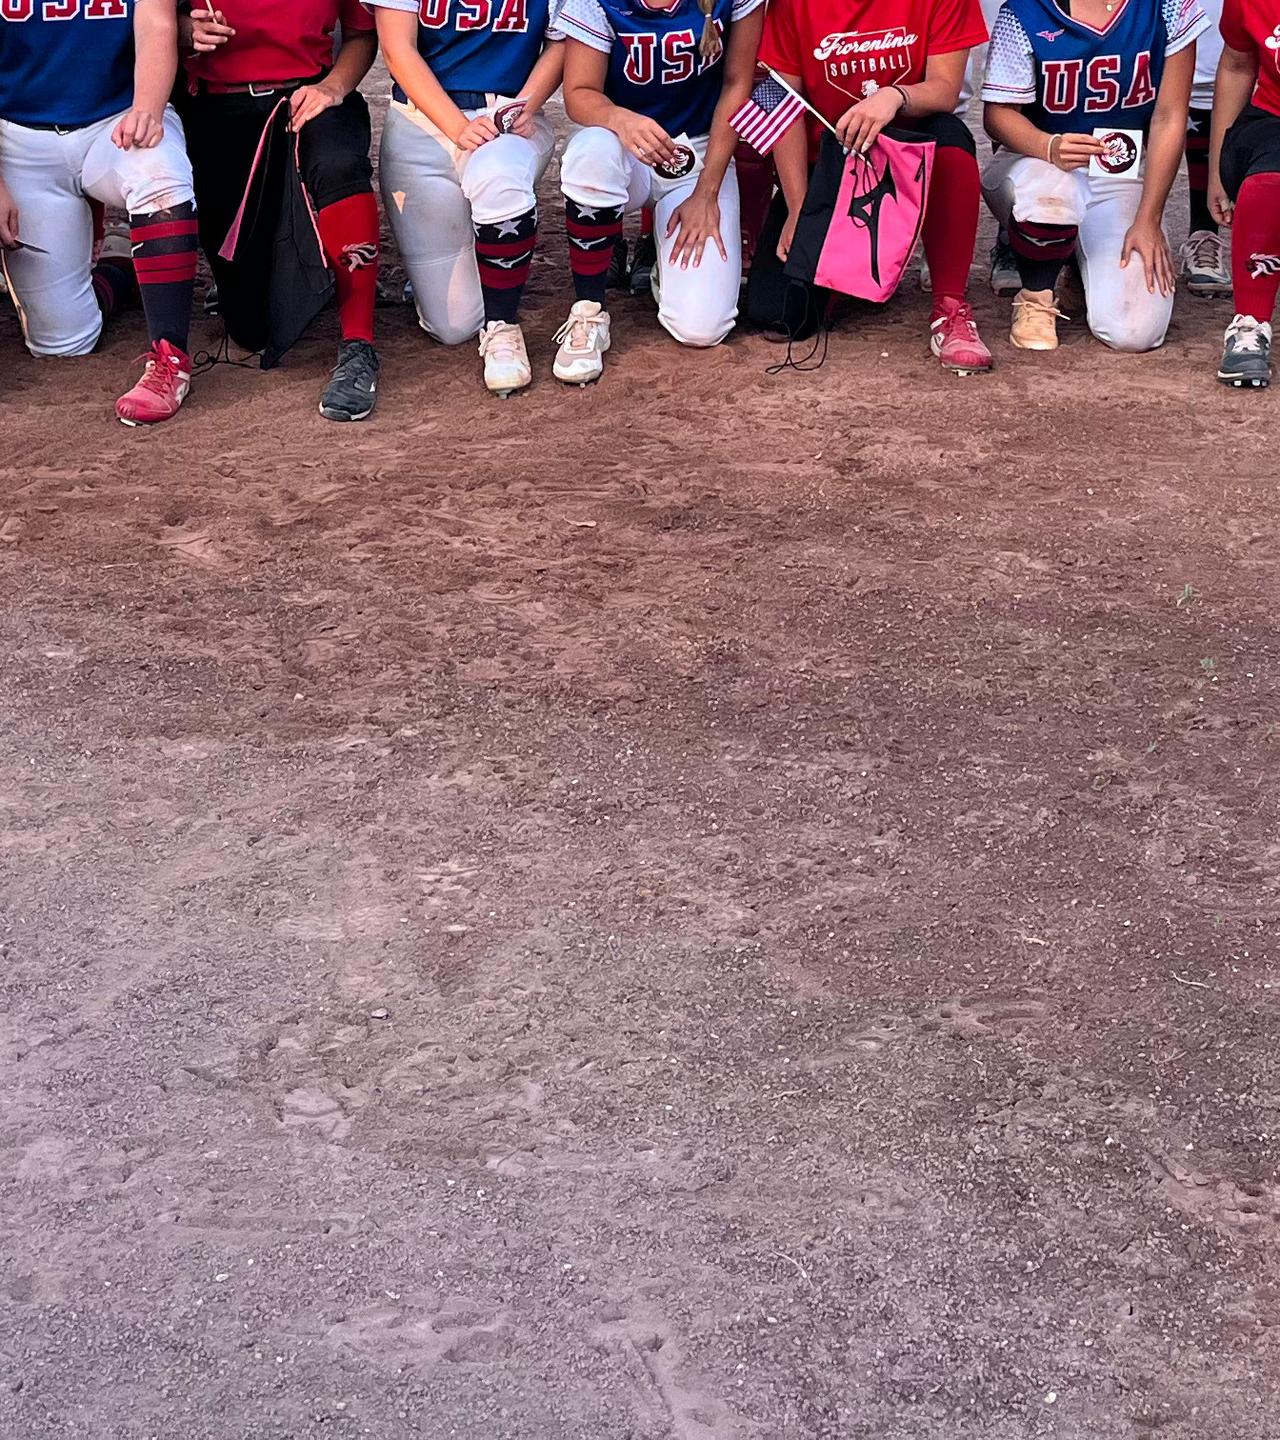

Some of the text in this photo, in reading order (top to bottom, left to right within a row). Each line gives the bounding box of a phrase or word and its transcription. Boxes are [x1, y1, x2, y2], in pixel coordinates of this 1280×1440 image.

[813, 31, 919, 61] Fiorentina
[829, 54, 906, 77] SOFTBALL
[1042, 50, 1156, 114] USA
